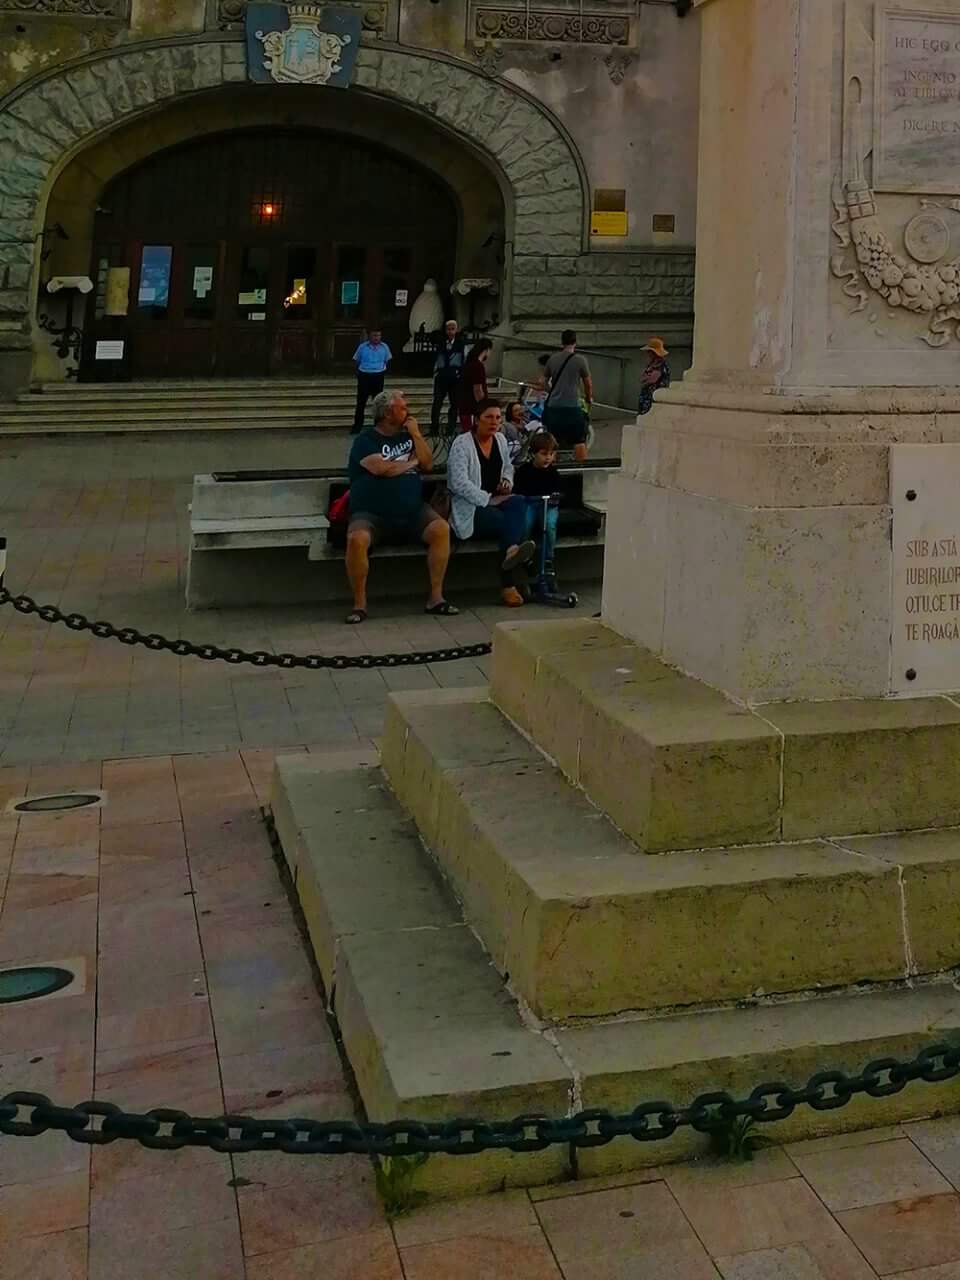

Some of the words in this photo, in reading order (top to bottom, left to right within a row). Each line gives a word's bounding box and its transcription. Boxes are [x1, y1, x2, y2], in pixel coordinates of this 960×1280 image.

[894, 36, 917, 50] HIC
[921, 38, 950, 53] EGO
[905, 539, 929, 558] SUB
[905, 623, 919, 641] TE
